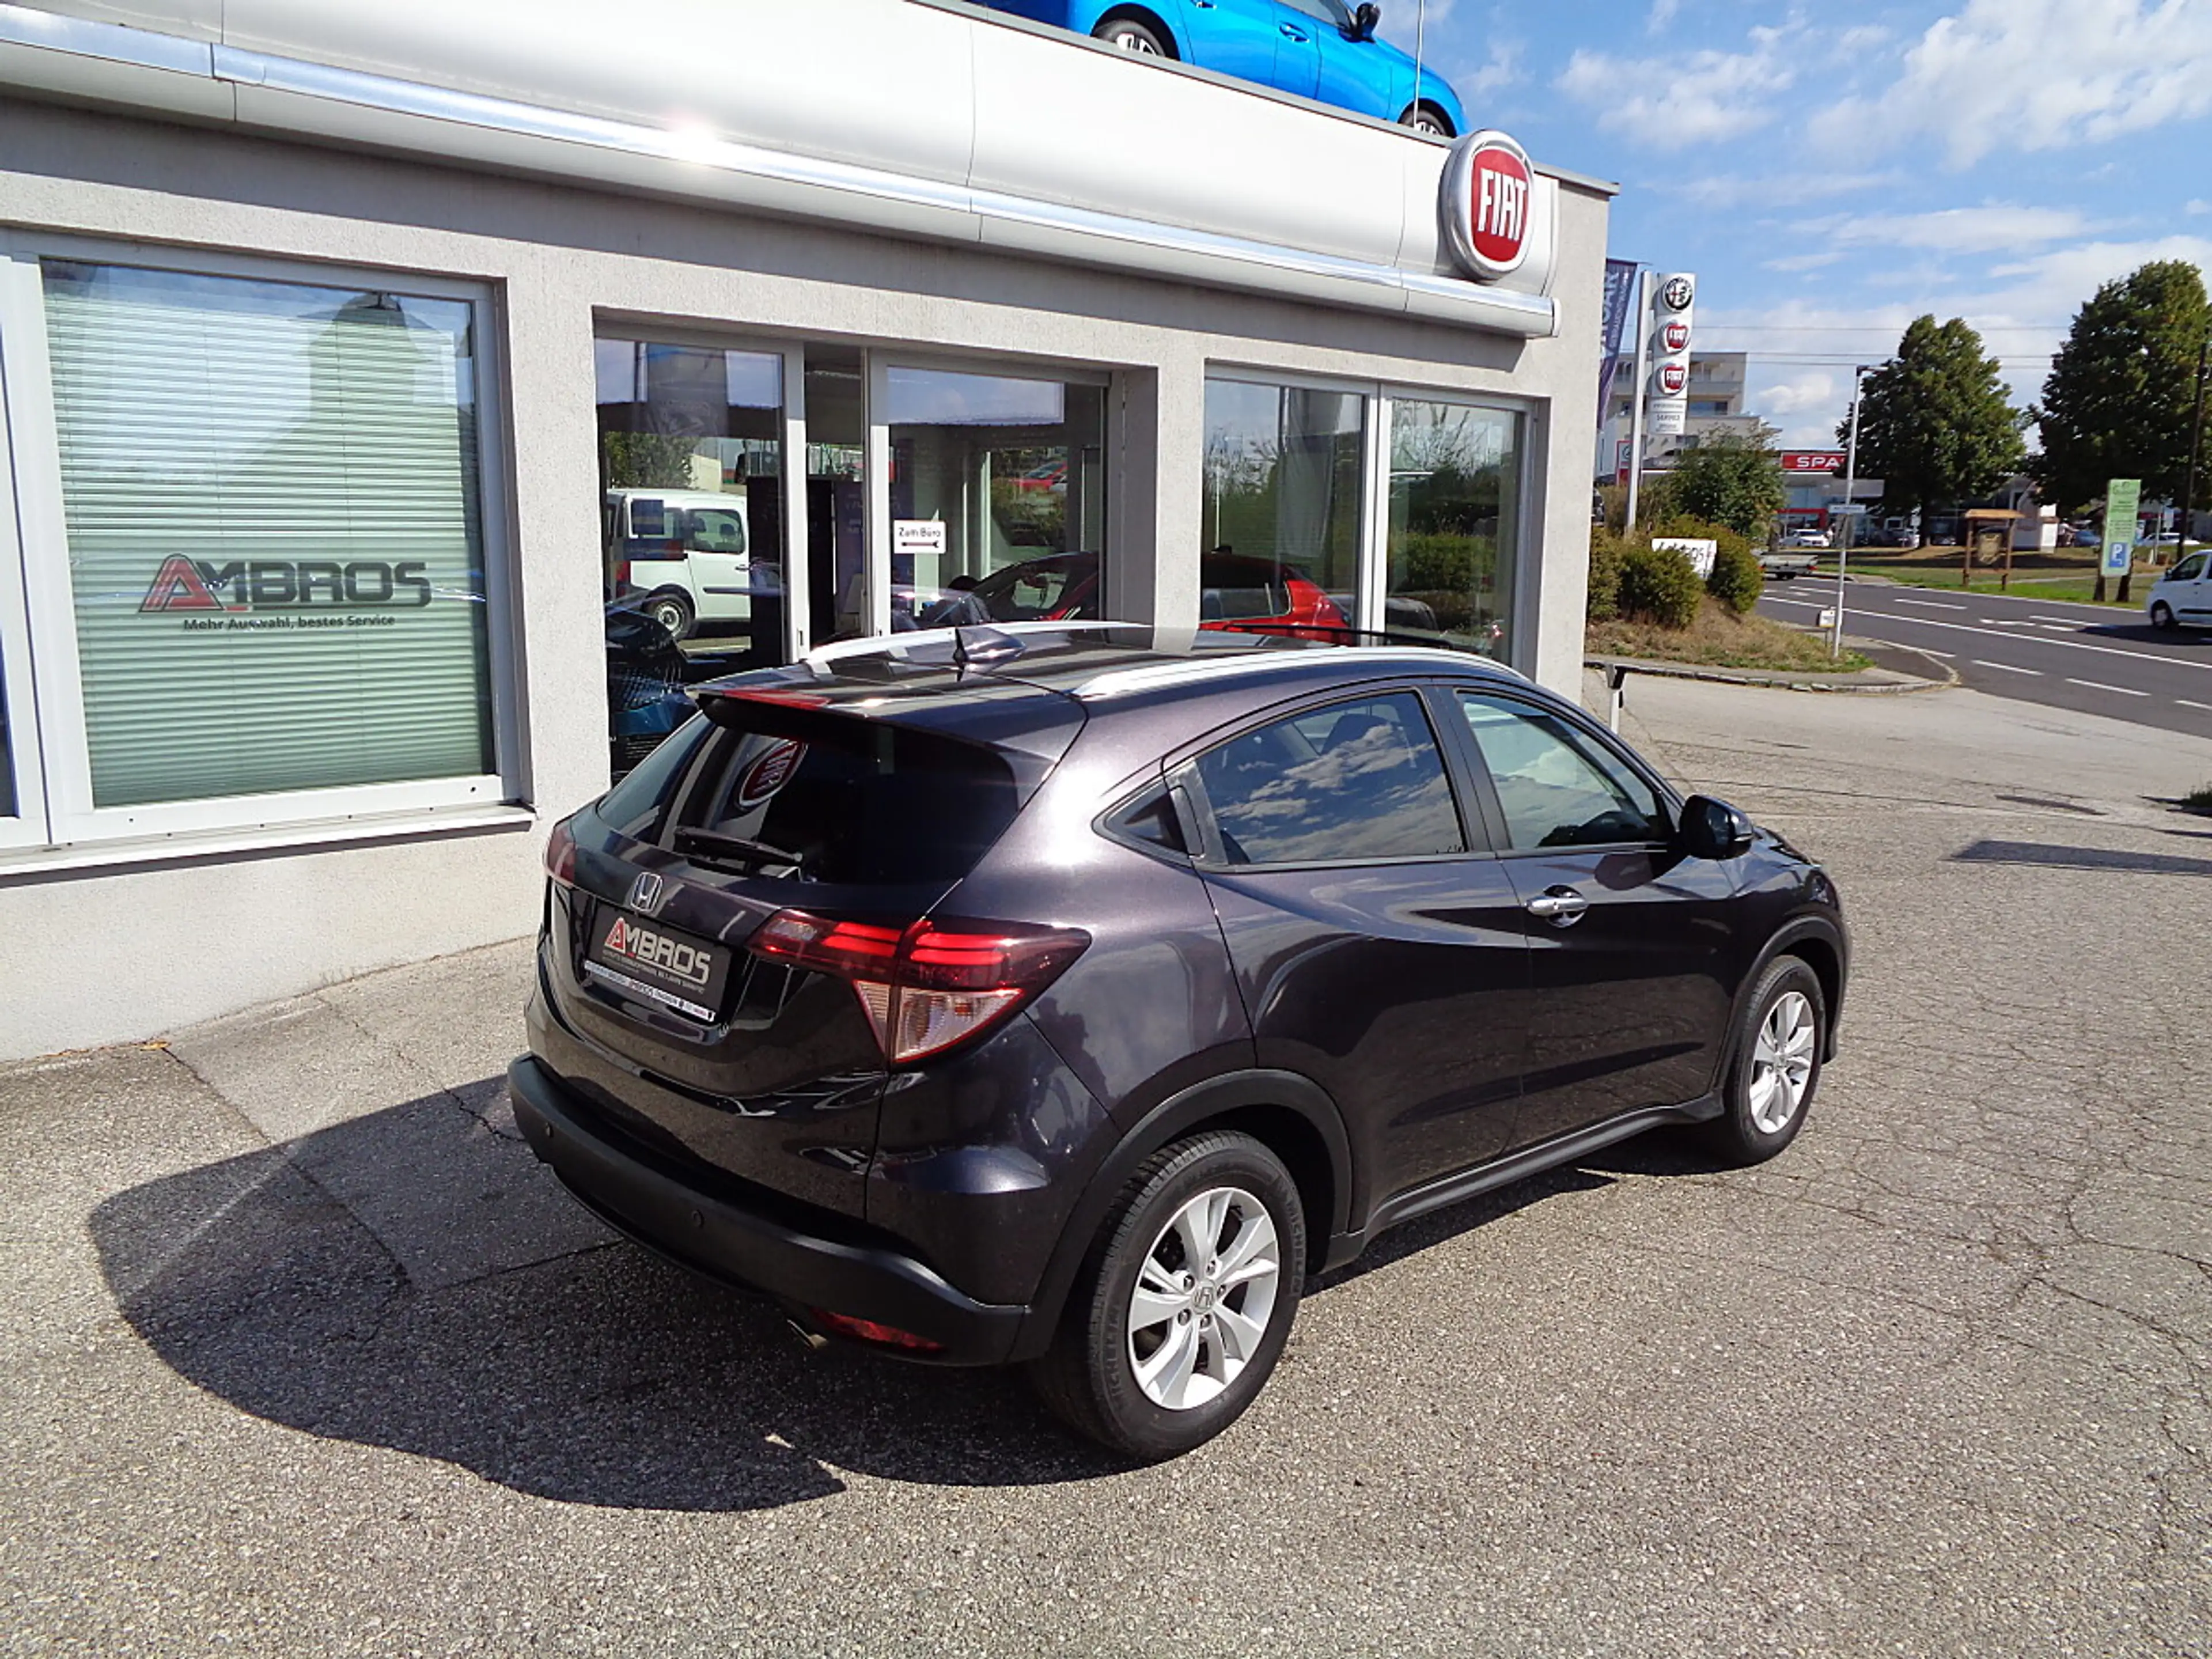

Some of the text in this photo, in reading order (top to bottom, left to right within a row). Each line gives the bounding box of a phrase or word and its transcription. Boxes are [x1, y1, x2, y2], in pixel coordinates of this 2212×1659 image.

[1478, 168, 1527, 241] FIAT
[1797, 457, 1846, 467] SPA
[899, 527, 941, 537] Zum Büro
[139, 553, 431, 612] AMBROS
[184, 615, 395, 630] Mehr Auswahl, bestes Service
[604, 916, 711, 984] AMBROS
